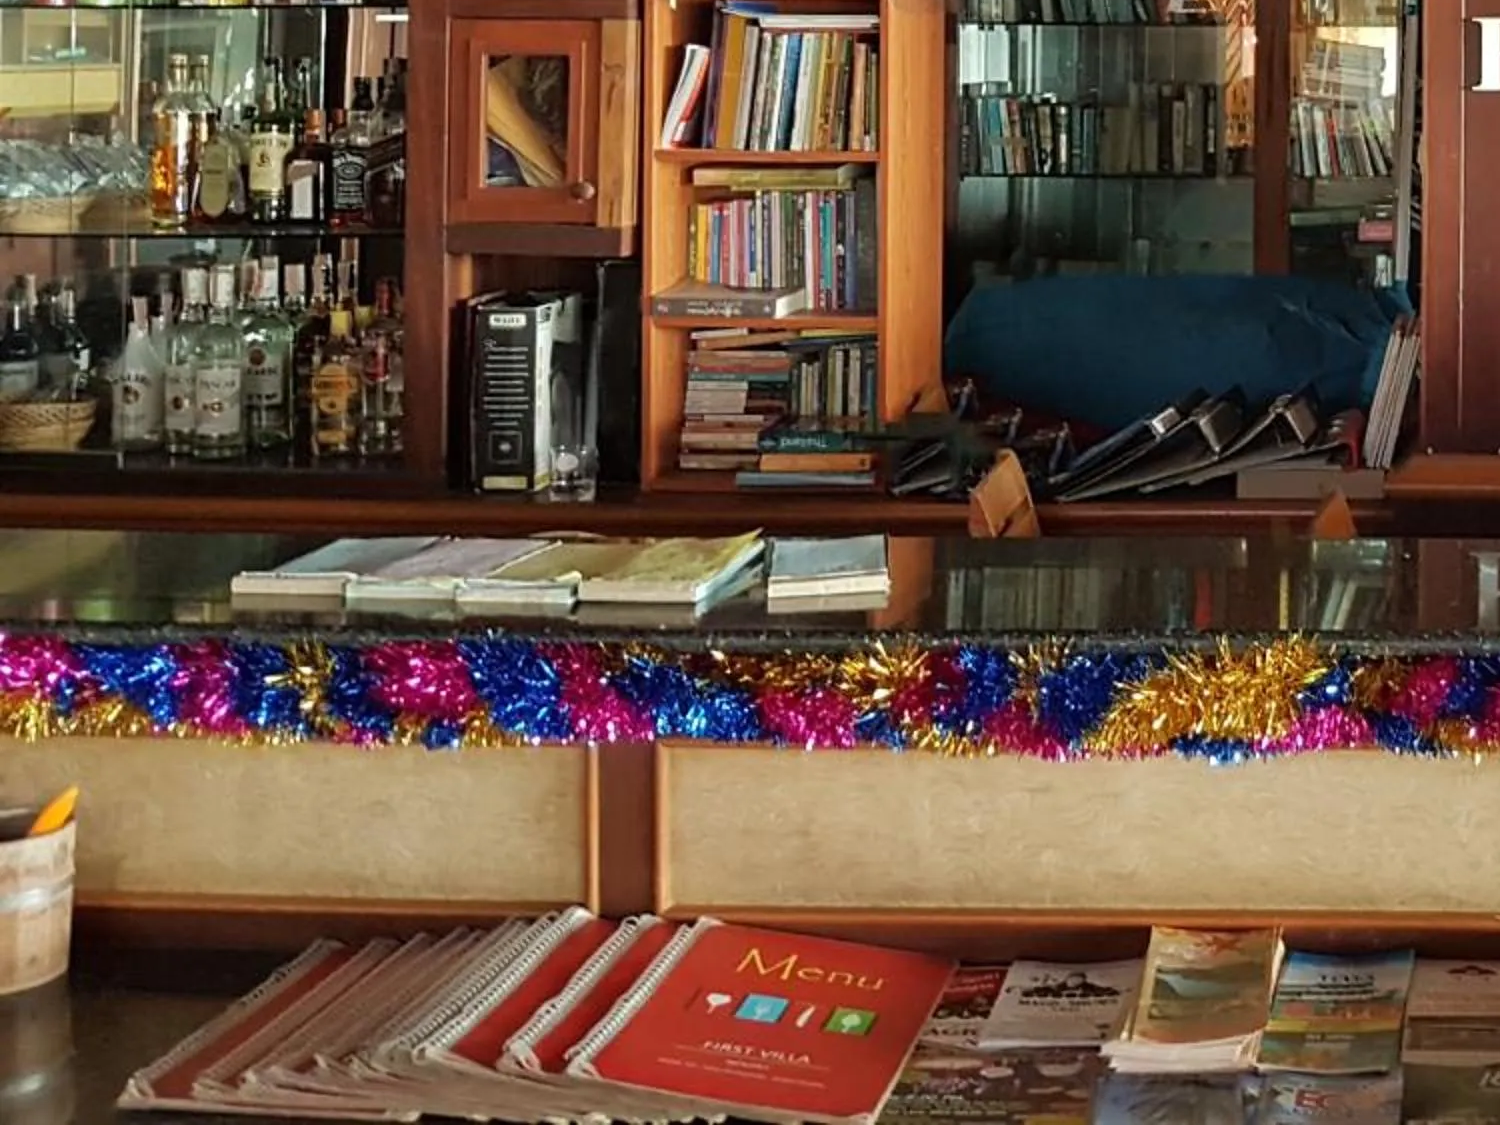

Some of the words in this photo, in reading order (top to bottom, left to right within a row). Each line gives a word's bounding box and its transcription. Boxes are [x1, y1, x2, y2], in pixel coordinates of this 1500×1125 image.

[736, 947, 886, 991] Menu
[703, 1039, 755, 1056] FIRST
[760, 1049, 811, 1065] VILLA
